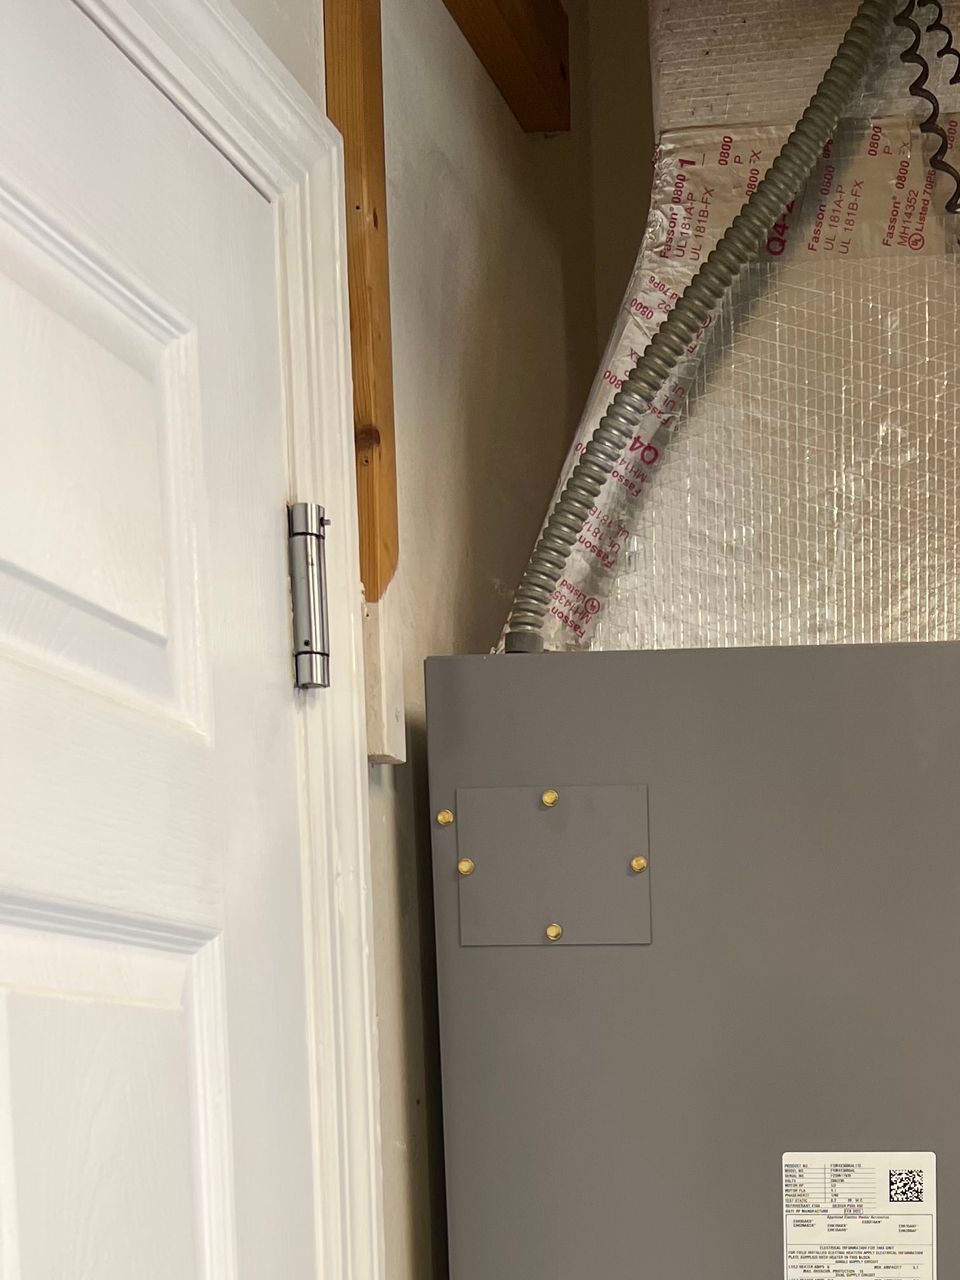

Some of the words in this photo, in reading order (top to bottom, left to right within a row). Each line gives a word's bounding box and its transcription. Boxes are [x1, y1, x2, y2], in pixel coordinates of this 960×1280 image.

[718, 136, 733, 166] 0800
[868, 126, 881, 156] 0800
[660, 212, 678, 259] Fasson
[672, 175, 686, 204] 0800
[681, 192, 697, 236] 181A-P
[808, 204, 826, 251] Fasson
[820, 165, 835, 195] 0800
[830, 185, 845, 229] 181A-P
[845, 180, 864, 231] 181B-FX
[883, 202, 901, 246] Fasson
[896, 161, 910, 189] 0800
[915, 199, 930, 232] Listed
[924, 169, 937, 196] 70P6
[690, 241, 700, 261] UL
[695, 187, 714, 237] 181B-FX
[897, 189, 919, 246] MH14352
[676, 239, 688, 258] UL
[824, 236, 837, 251] UL
[840, 239, 851, 254] UL
[649, 275, 671, 296] 70P6
[630, 297, 654, 321] 0800
[603, 369, 625, 390] 800
[611, 470, 642, 498] Fasso
[577, 535, 617, 569] Fasson
[560, 579, 587, 601] Listed
[550, 606, 586, 639] Fasson
[551, 590, 592, 624] MH1435
